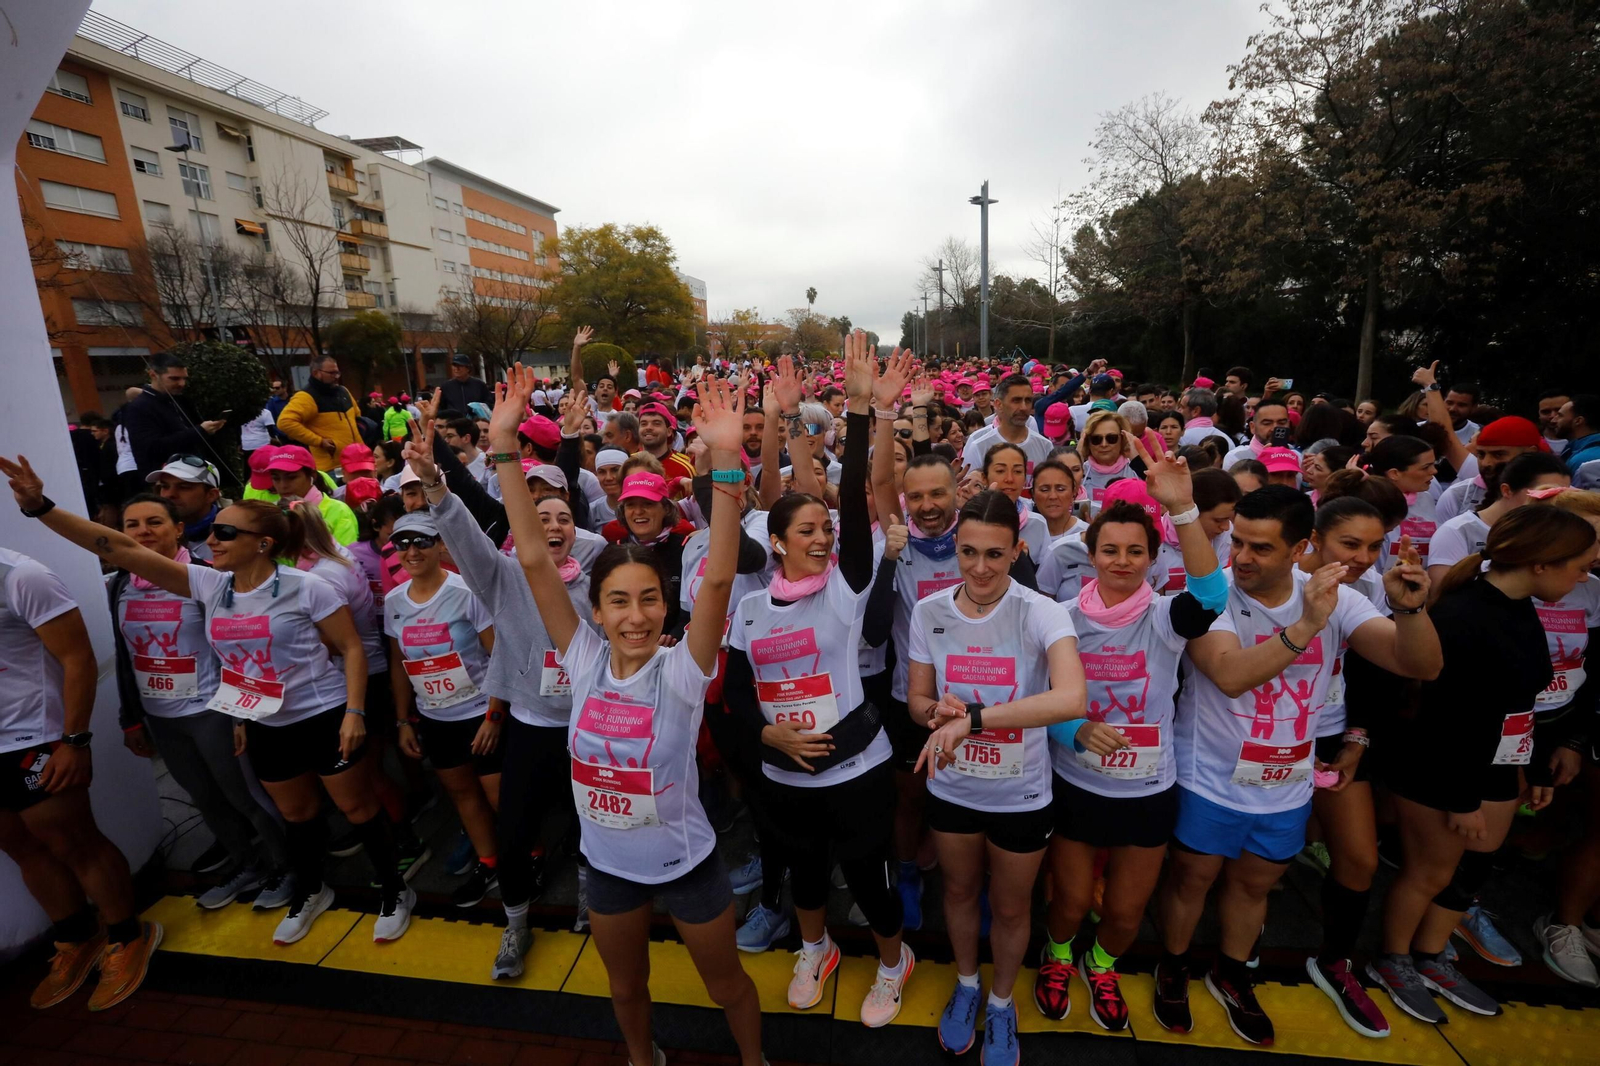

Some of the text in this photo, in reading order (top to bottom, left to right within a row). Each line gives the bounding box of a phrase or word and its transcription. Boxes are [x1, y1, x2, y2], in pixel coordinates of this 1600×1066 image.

[757, 638, 808, 655] PINK RUNNING
[768, 651, 791, 660] CADENA
[972, 667, 1007, 675] RUNNING
[1104, 662, 1138, 671] RUNNING
[147, 677, 174, 690] 466
[424, 678, 455, 695] 976
[780, 683, 796, 691] 100
[235, 692, 262, 709] 767
[587, 709, 644, 725] PINK RUNNING
[610, 706, 630, 715] Edición
[775, 710, 816, 730] 650
[594, 722, 619, 732] CADENA
[963, 743, 1001, 765] 1755
[1100, 752, 1138, 768] 1227
[599, 769, 614, 778] 100
[1261, 768, 1293, 781] 547
[588, 790, 633, 816] 2482
